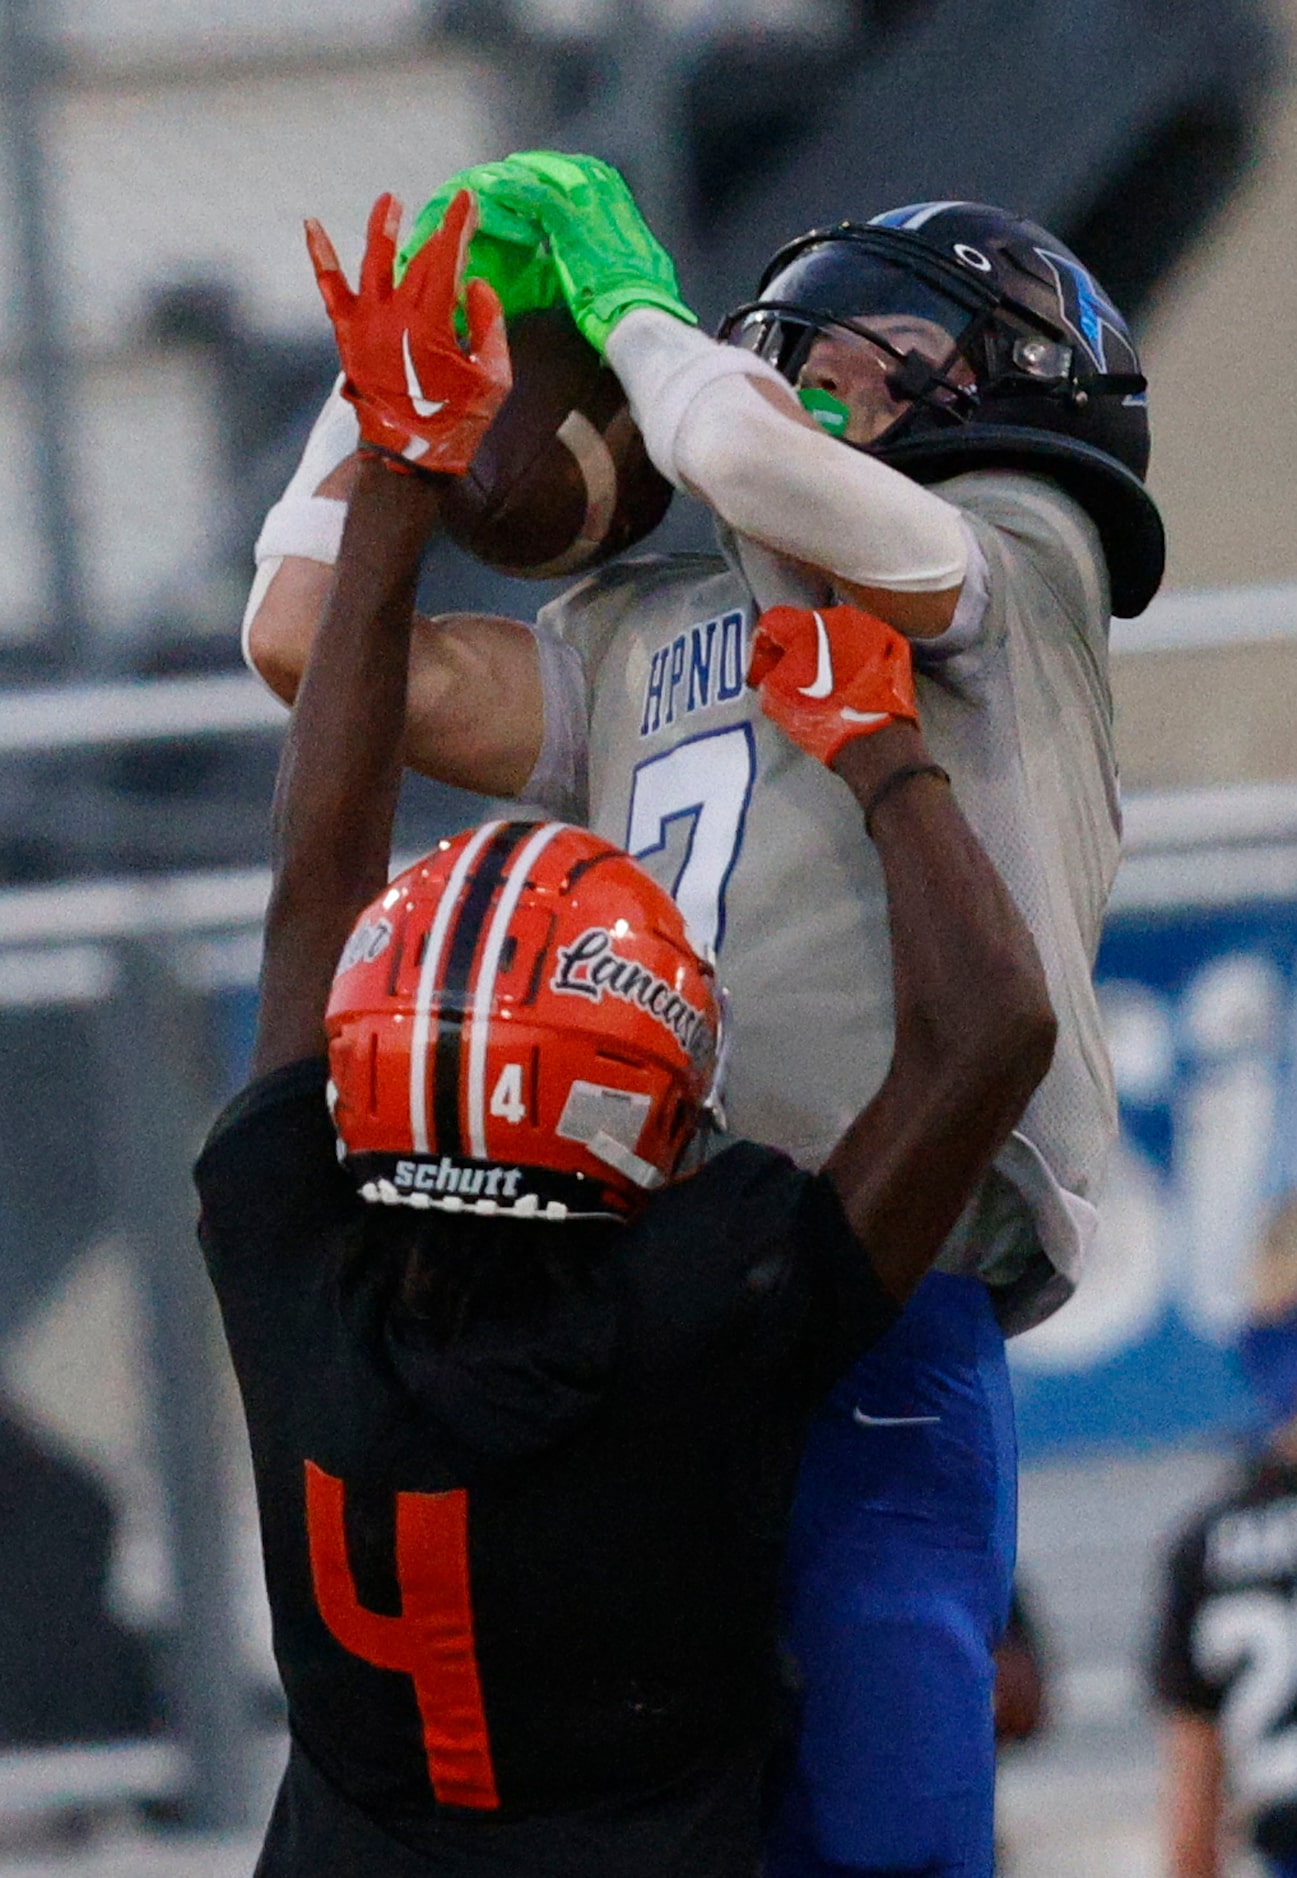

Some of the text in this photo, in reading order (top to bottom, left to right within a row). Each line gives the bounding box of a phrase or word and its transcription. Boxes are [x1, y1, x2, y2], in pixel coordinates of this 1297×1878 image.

[626, 720, 757, 955] 7
[489, 1062, 526, 1124] 4
[394, 1156, 522, 1197] schutt
[304, 1458, 500, 1811] 4
